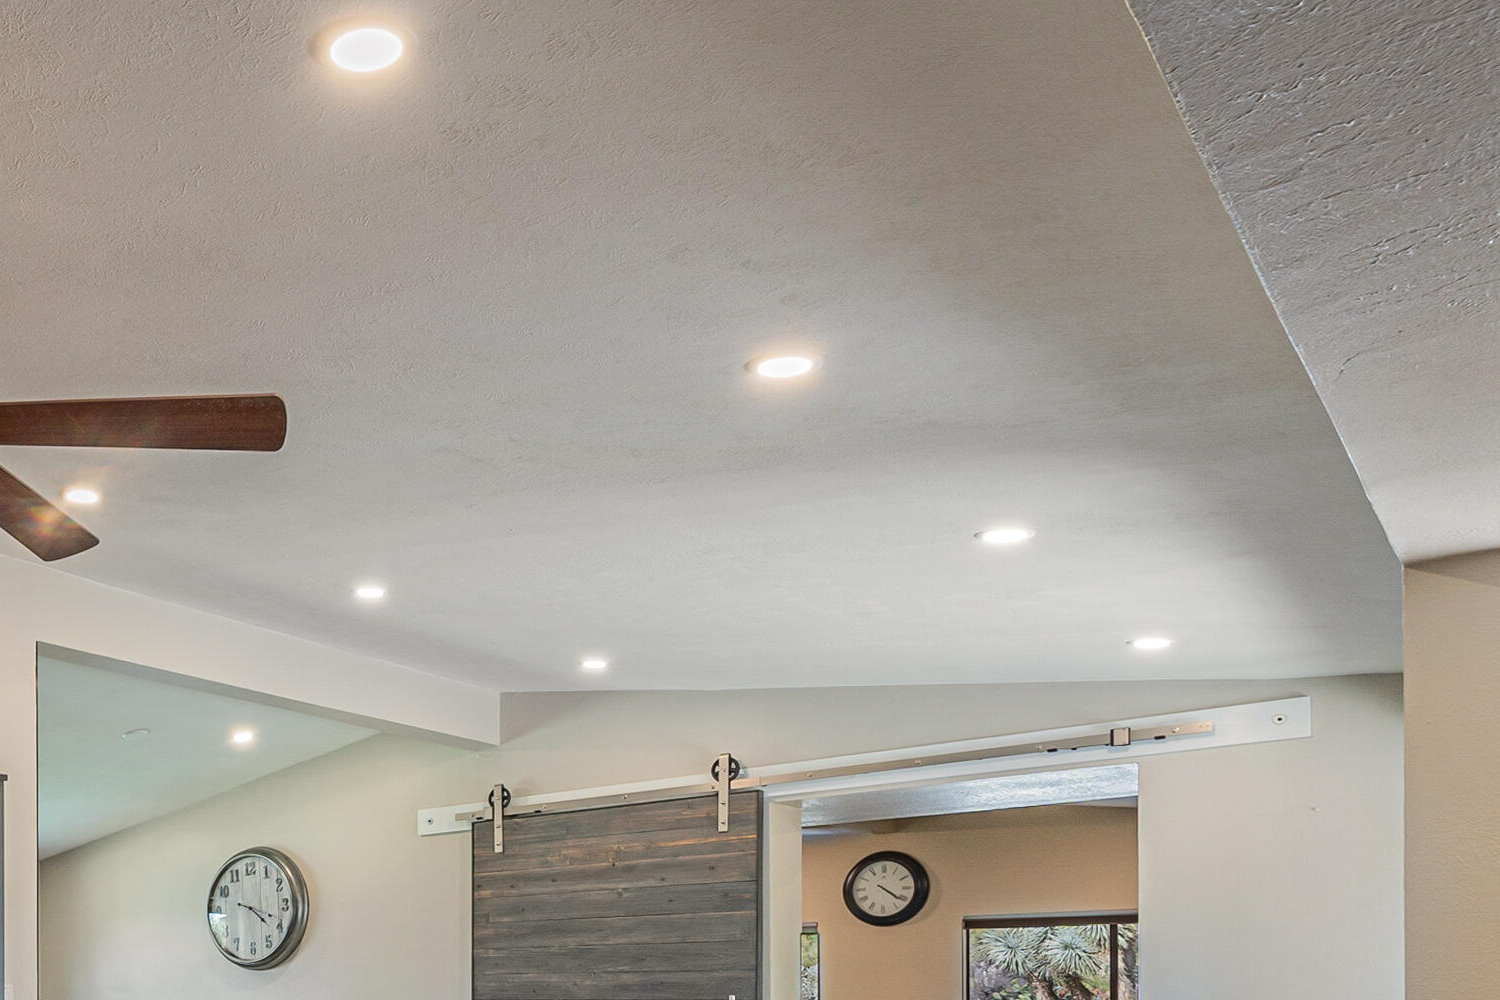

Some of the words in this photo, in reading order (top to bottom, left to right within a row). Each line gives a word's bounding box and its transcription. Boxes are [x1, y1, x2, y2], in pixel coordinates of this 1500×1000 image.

[245, 861, 256, 876] 12
[263, 865, 270, 879] 1
[229, 869, 240, 883] 11
[220, 885, 230, 898] 10
[276, 878, 283, 893] 2
[282, 898, 289, 912] 3
[250, 942, 256, 955] 6
[265, 935, 273, 949] 5
